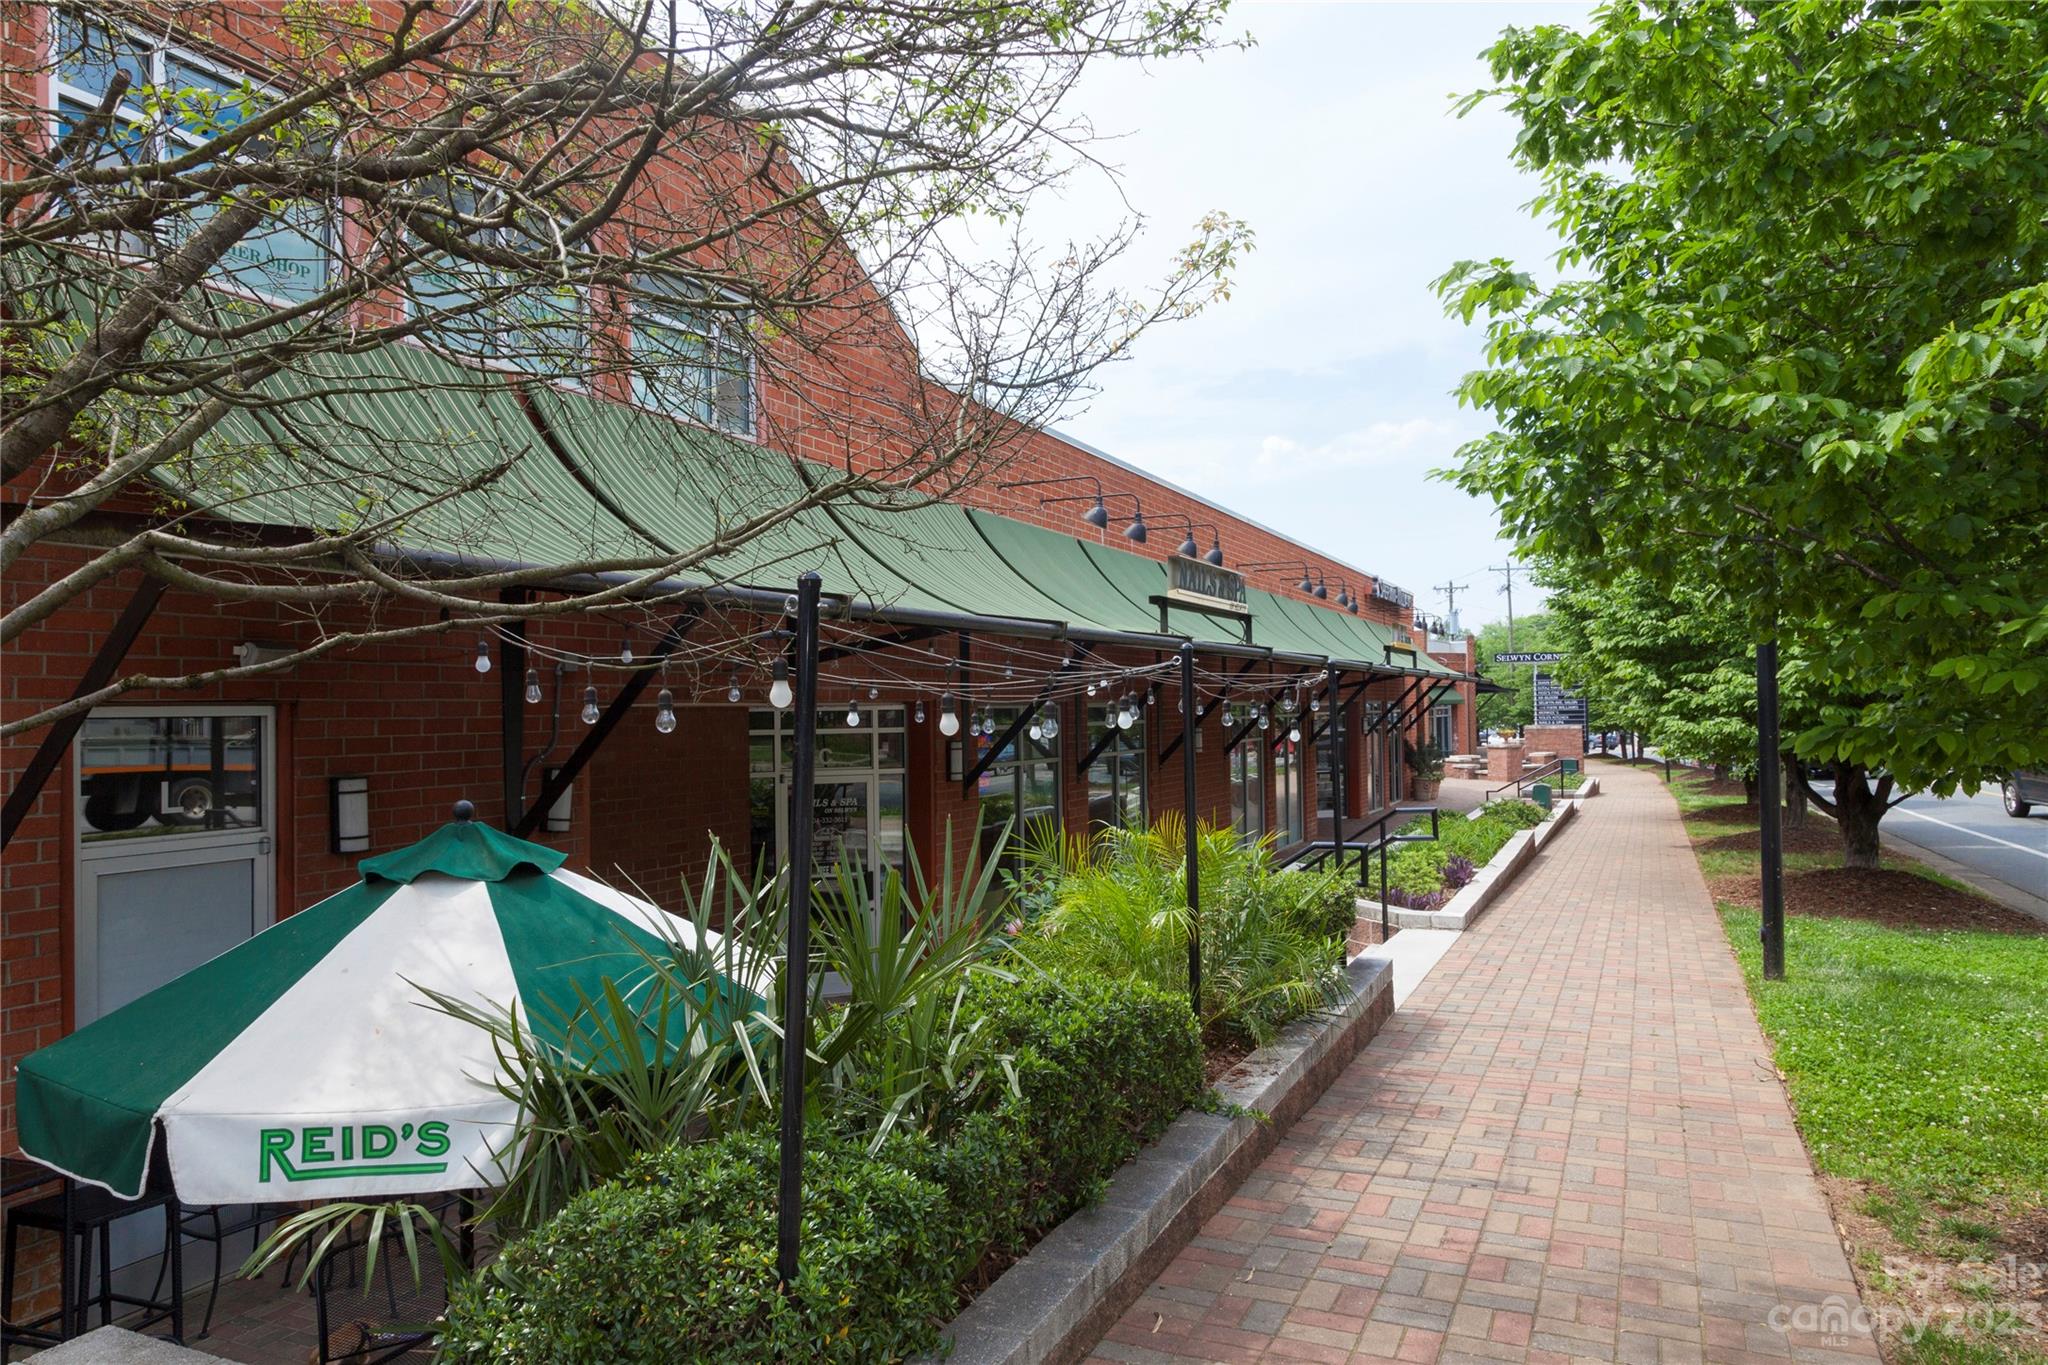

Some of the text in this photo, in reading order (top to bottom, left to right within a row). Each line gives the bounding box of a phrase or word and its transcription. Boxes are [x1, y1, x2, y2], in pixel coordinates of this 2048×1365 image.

[266, 253, 310, 278] SHOP
[1180, 561, 1216, 597] NAILS
[1227, 574, 1246, 603] SPA
[1496, 653, 1560, 662] SELWYN CORN
[161, 781, 184, 814] L
[813, 799, 829, 807] ILS
[840, 798, 858, 806] SPA
[259, 1120, 451, 1183] REID'S
